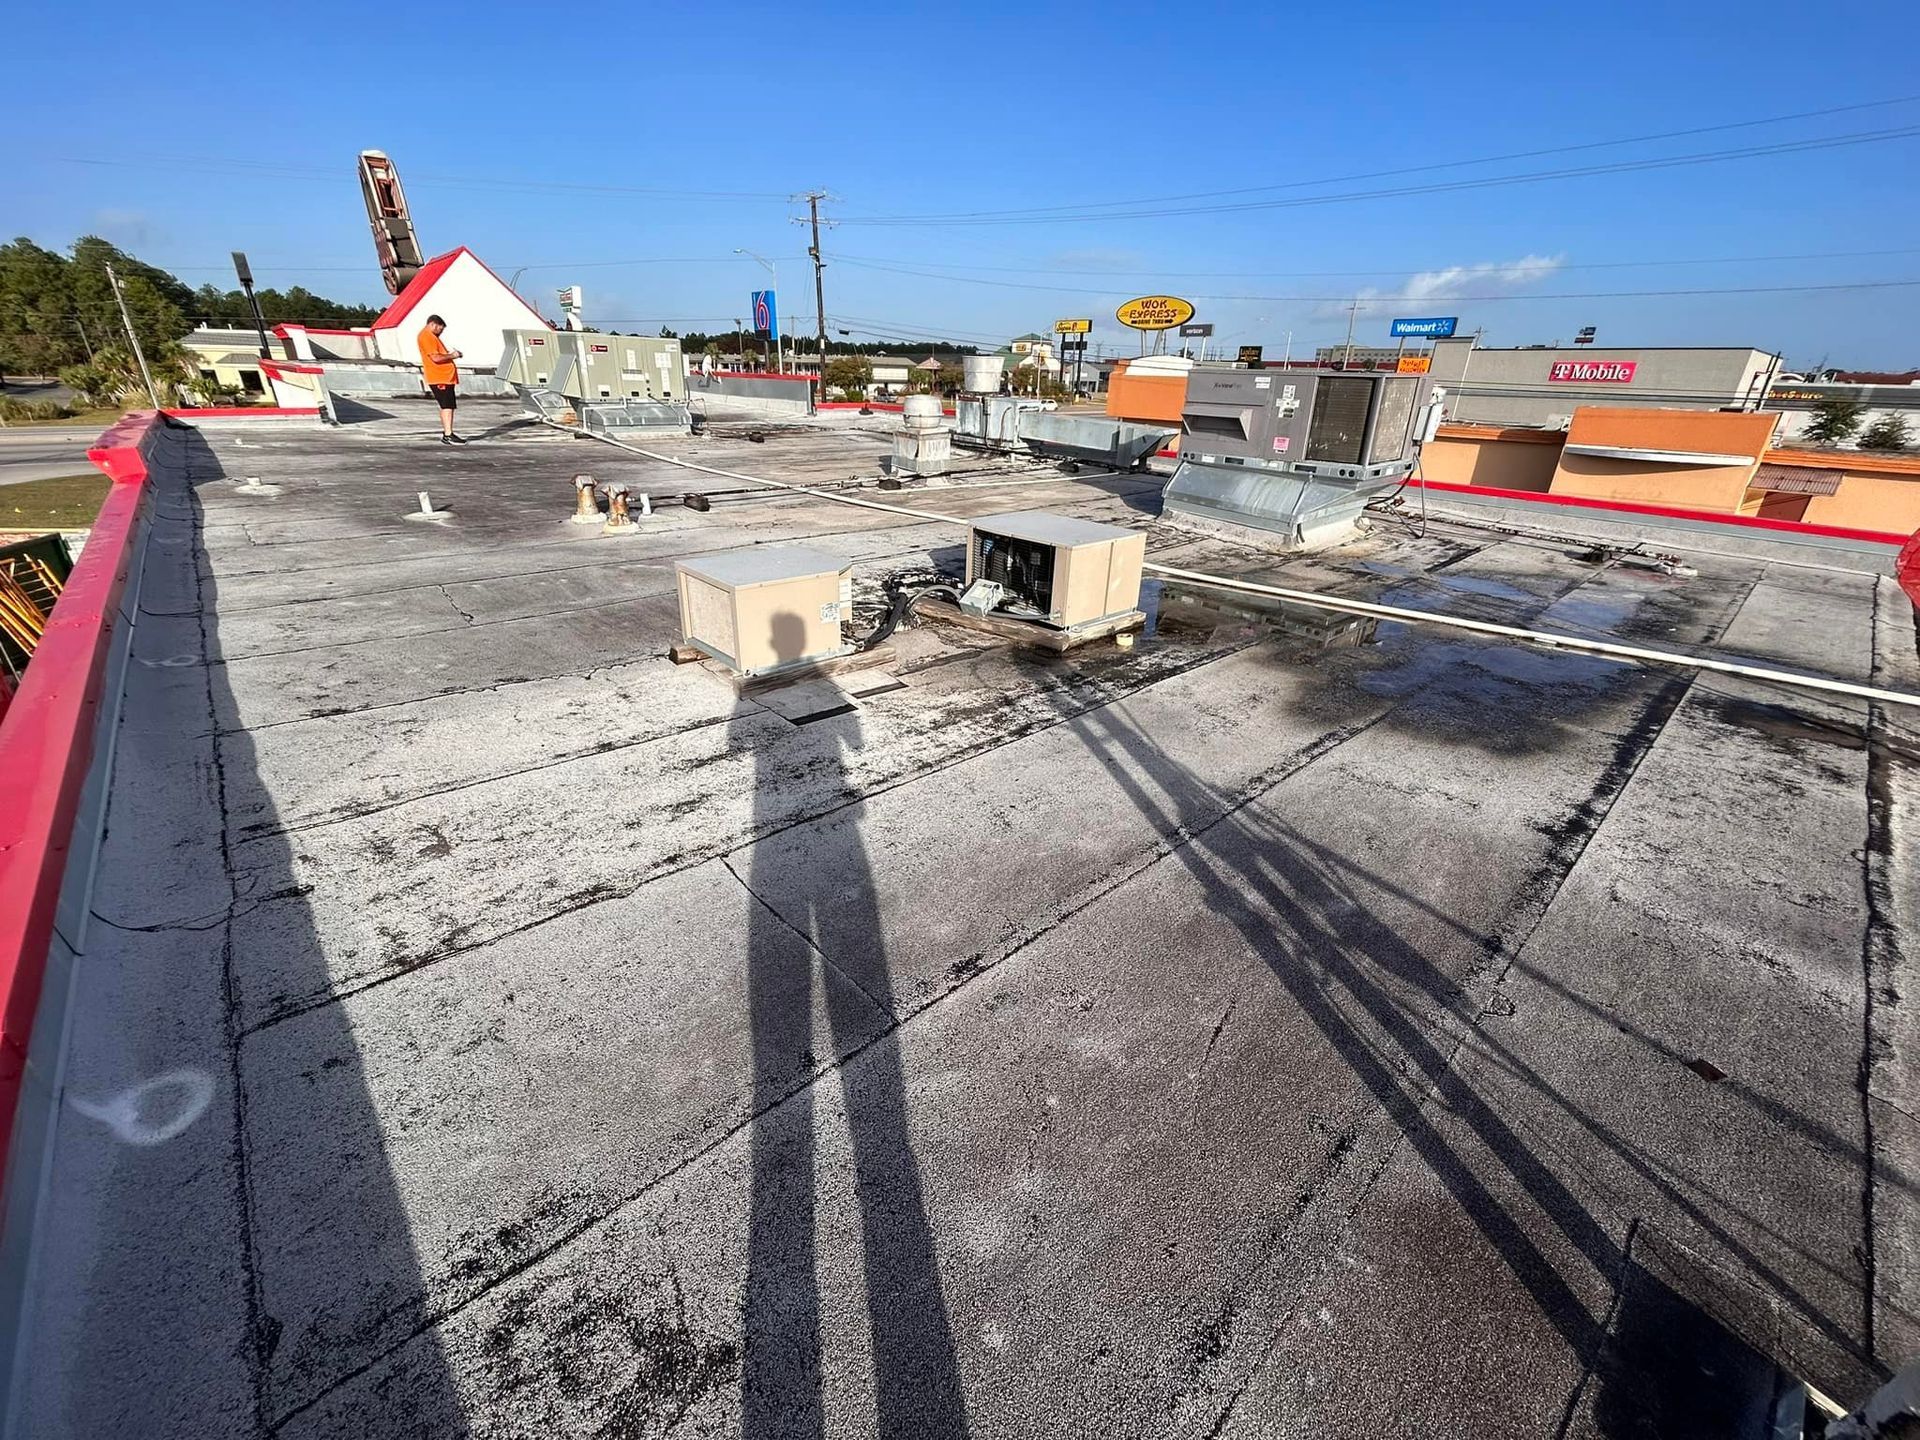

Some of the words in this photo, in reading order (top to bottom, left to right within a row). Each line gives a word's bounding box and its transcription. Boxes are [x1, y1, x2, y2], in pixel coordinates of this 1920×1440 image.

[756, 289, 770, 330] 6
[1141, 299, 1168, 309] WOK
[1129, 308, 1178, 319] EXPRESS
[1396, 321, 1437, 333] Walmart
